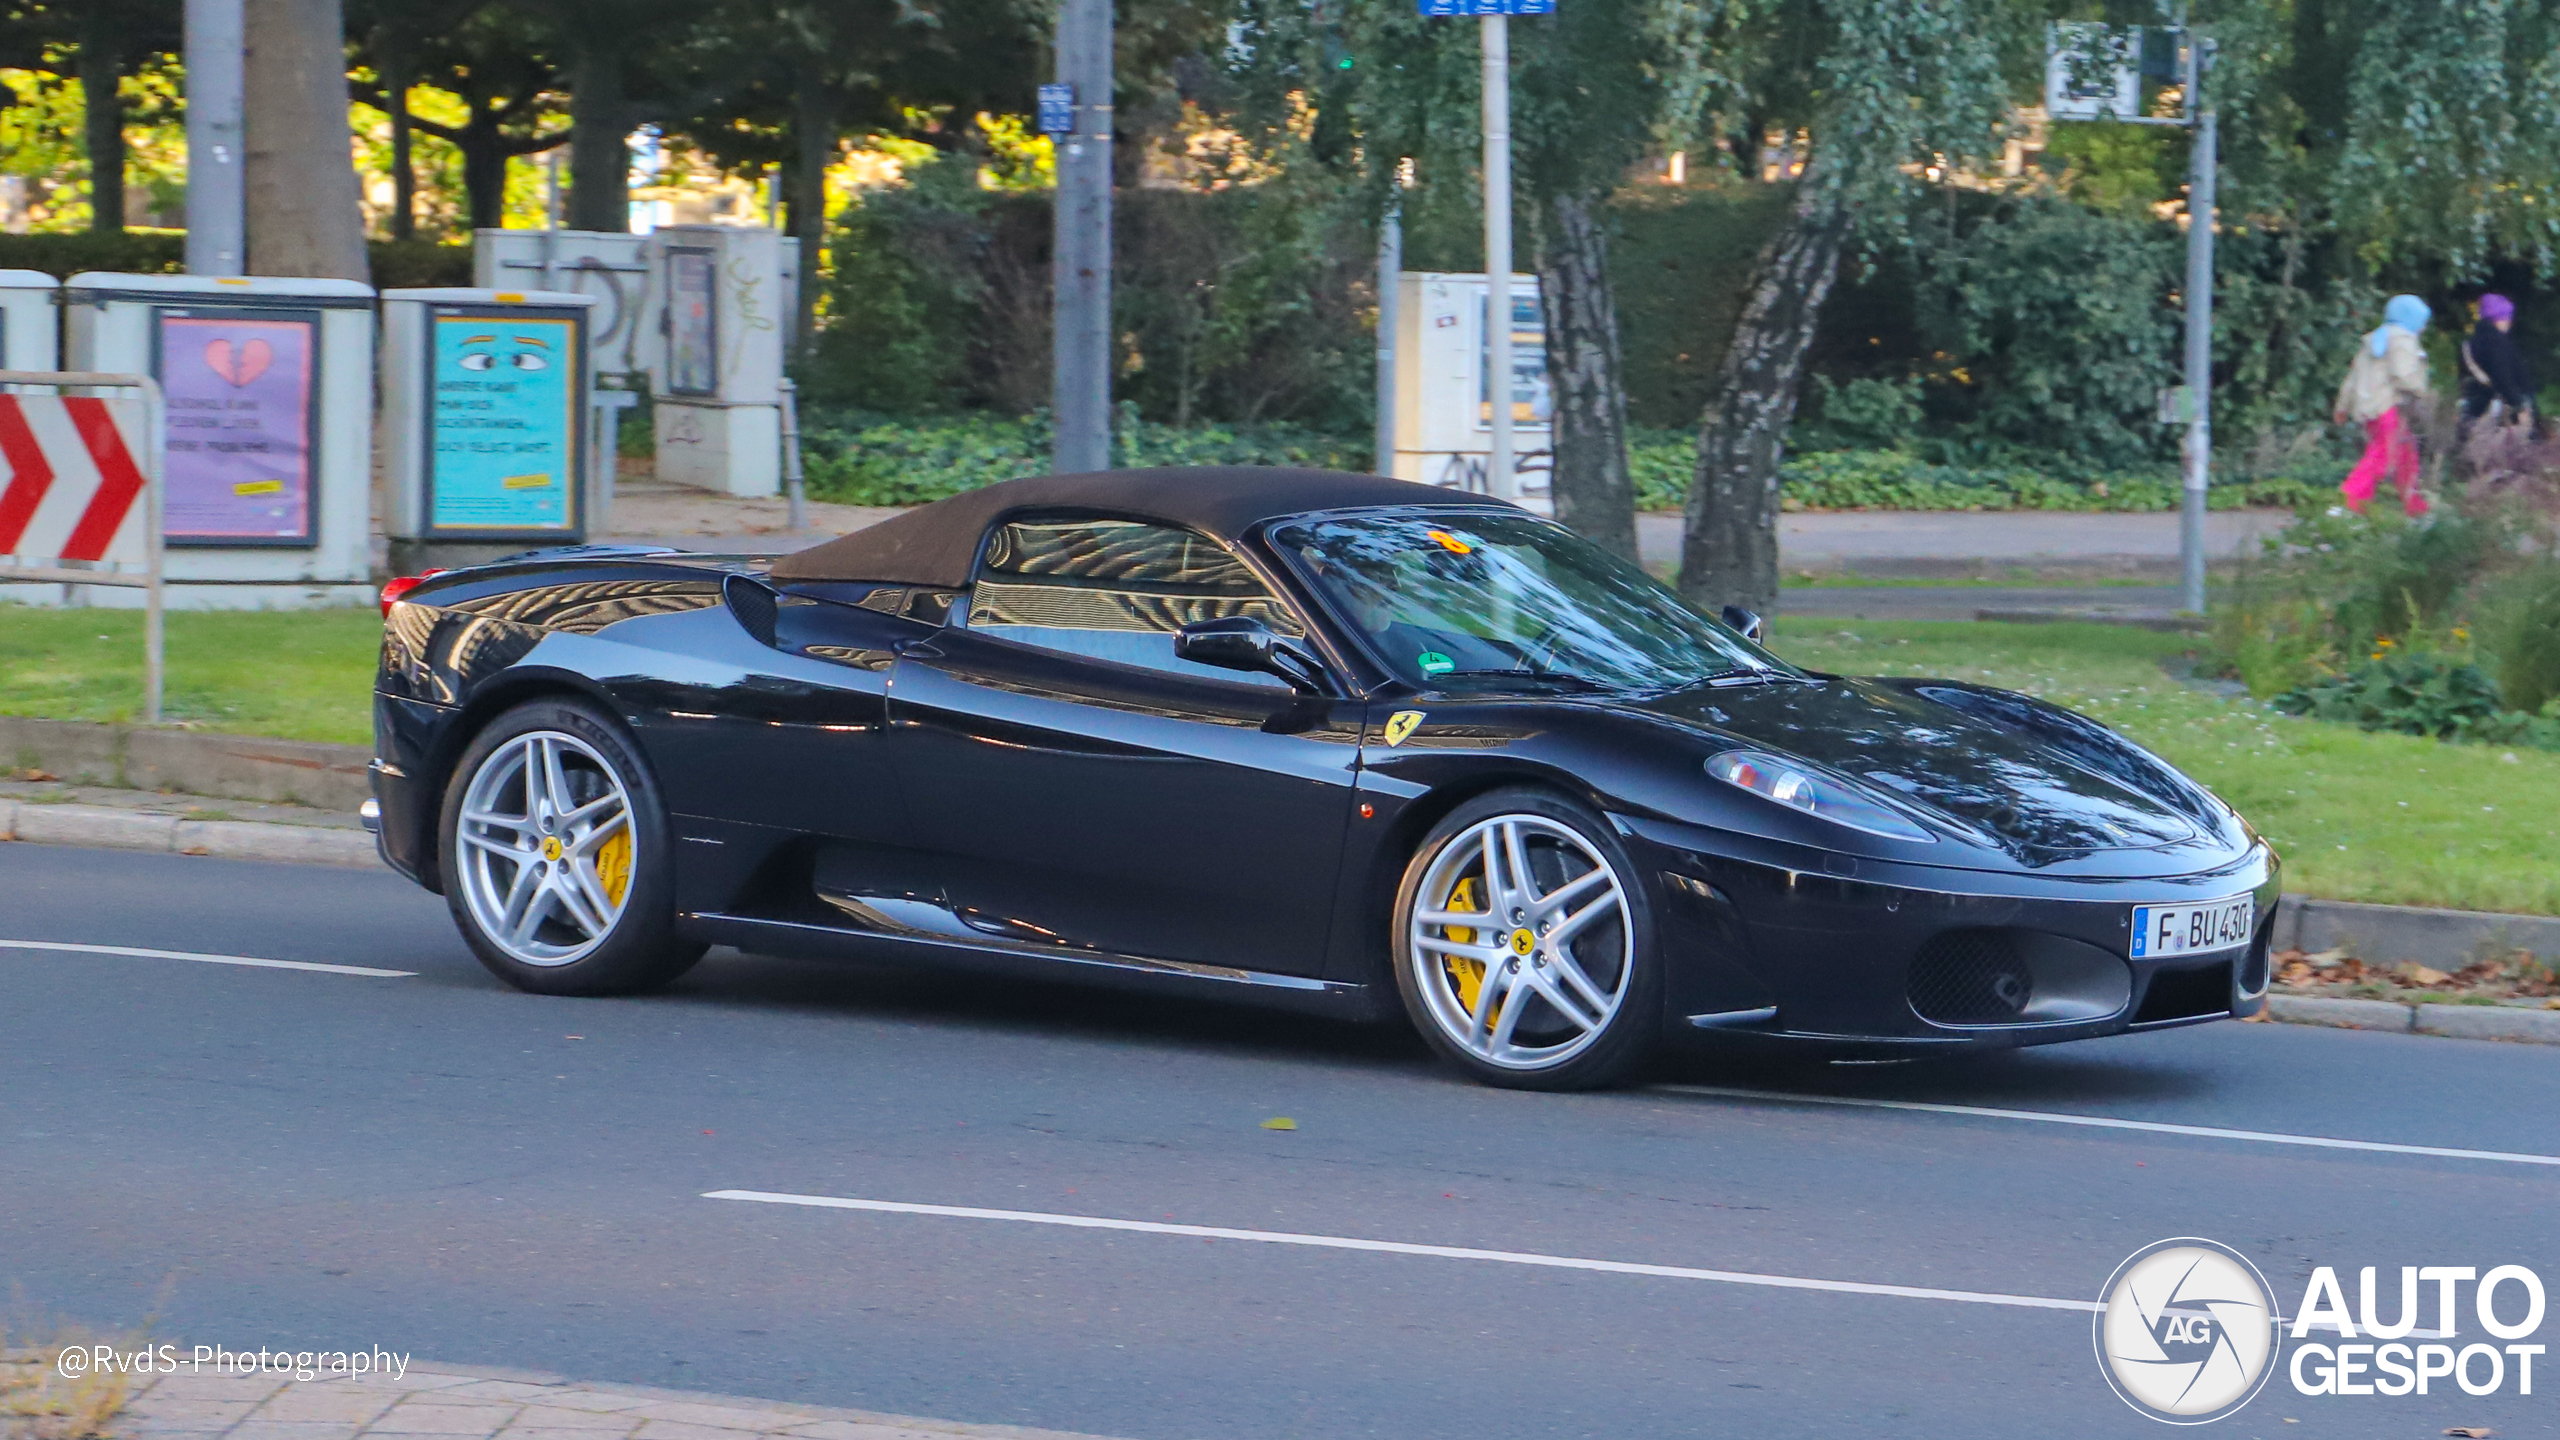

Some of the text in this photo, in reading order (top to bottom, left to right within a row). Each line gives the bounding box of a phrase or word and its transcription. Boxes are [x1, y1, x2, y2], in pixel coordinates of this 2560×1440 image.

[2158, 903, 2247, 949] F BU 430
[2135, 938, 2143, 950] D
